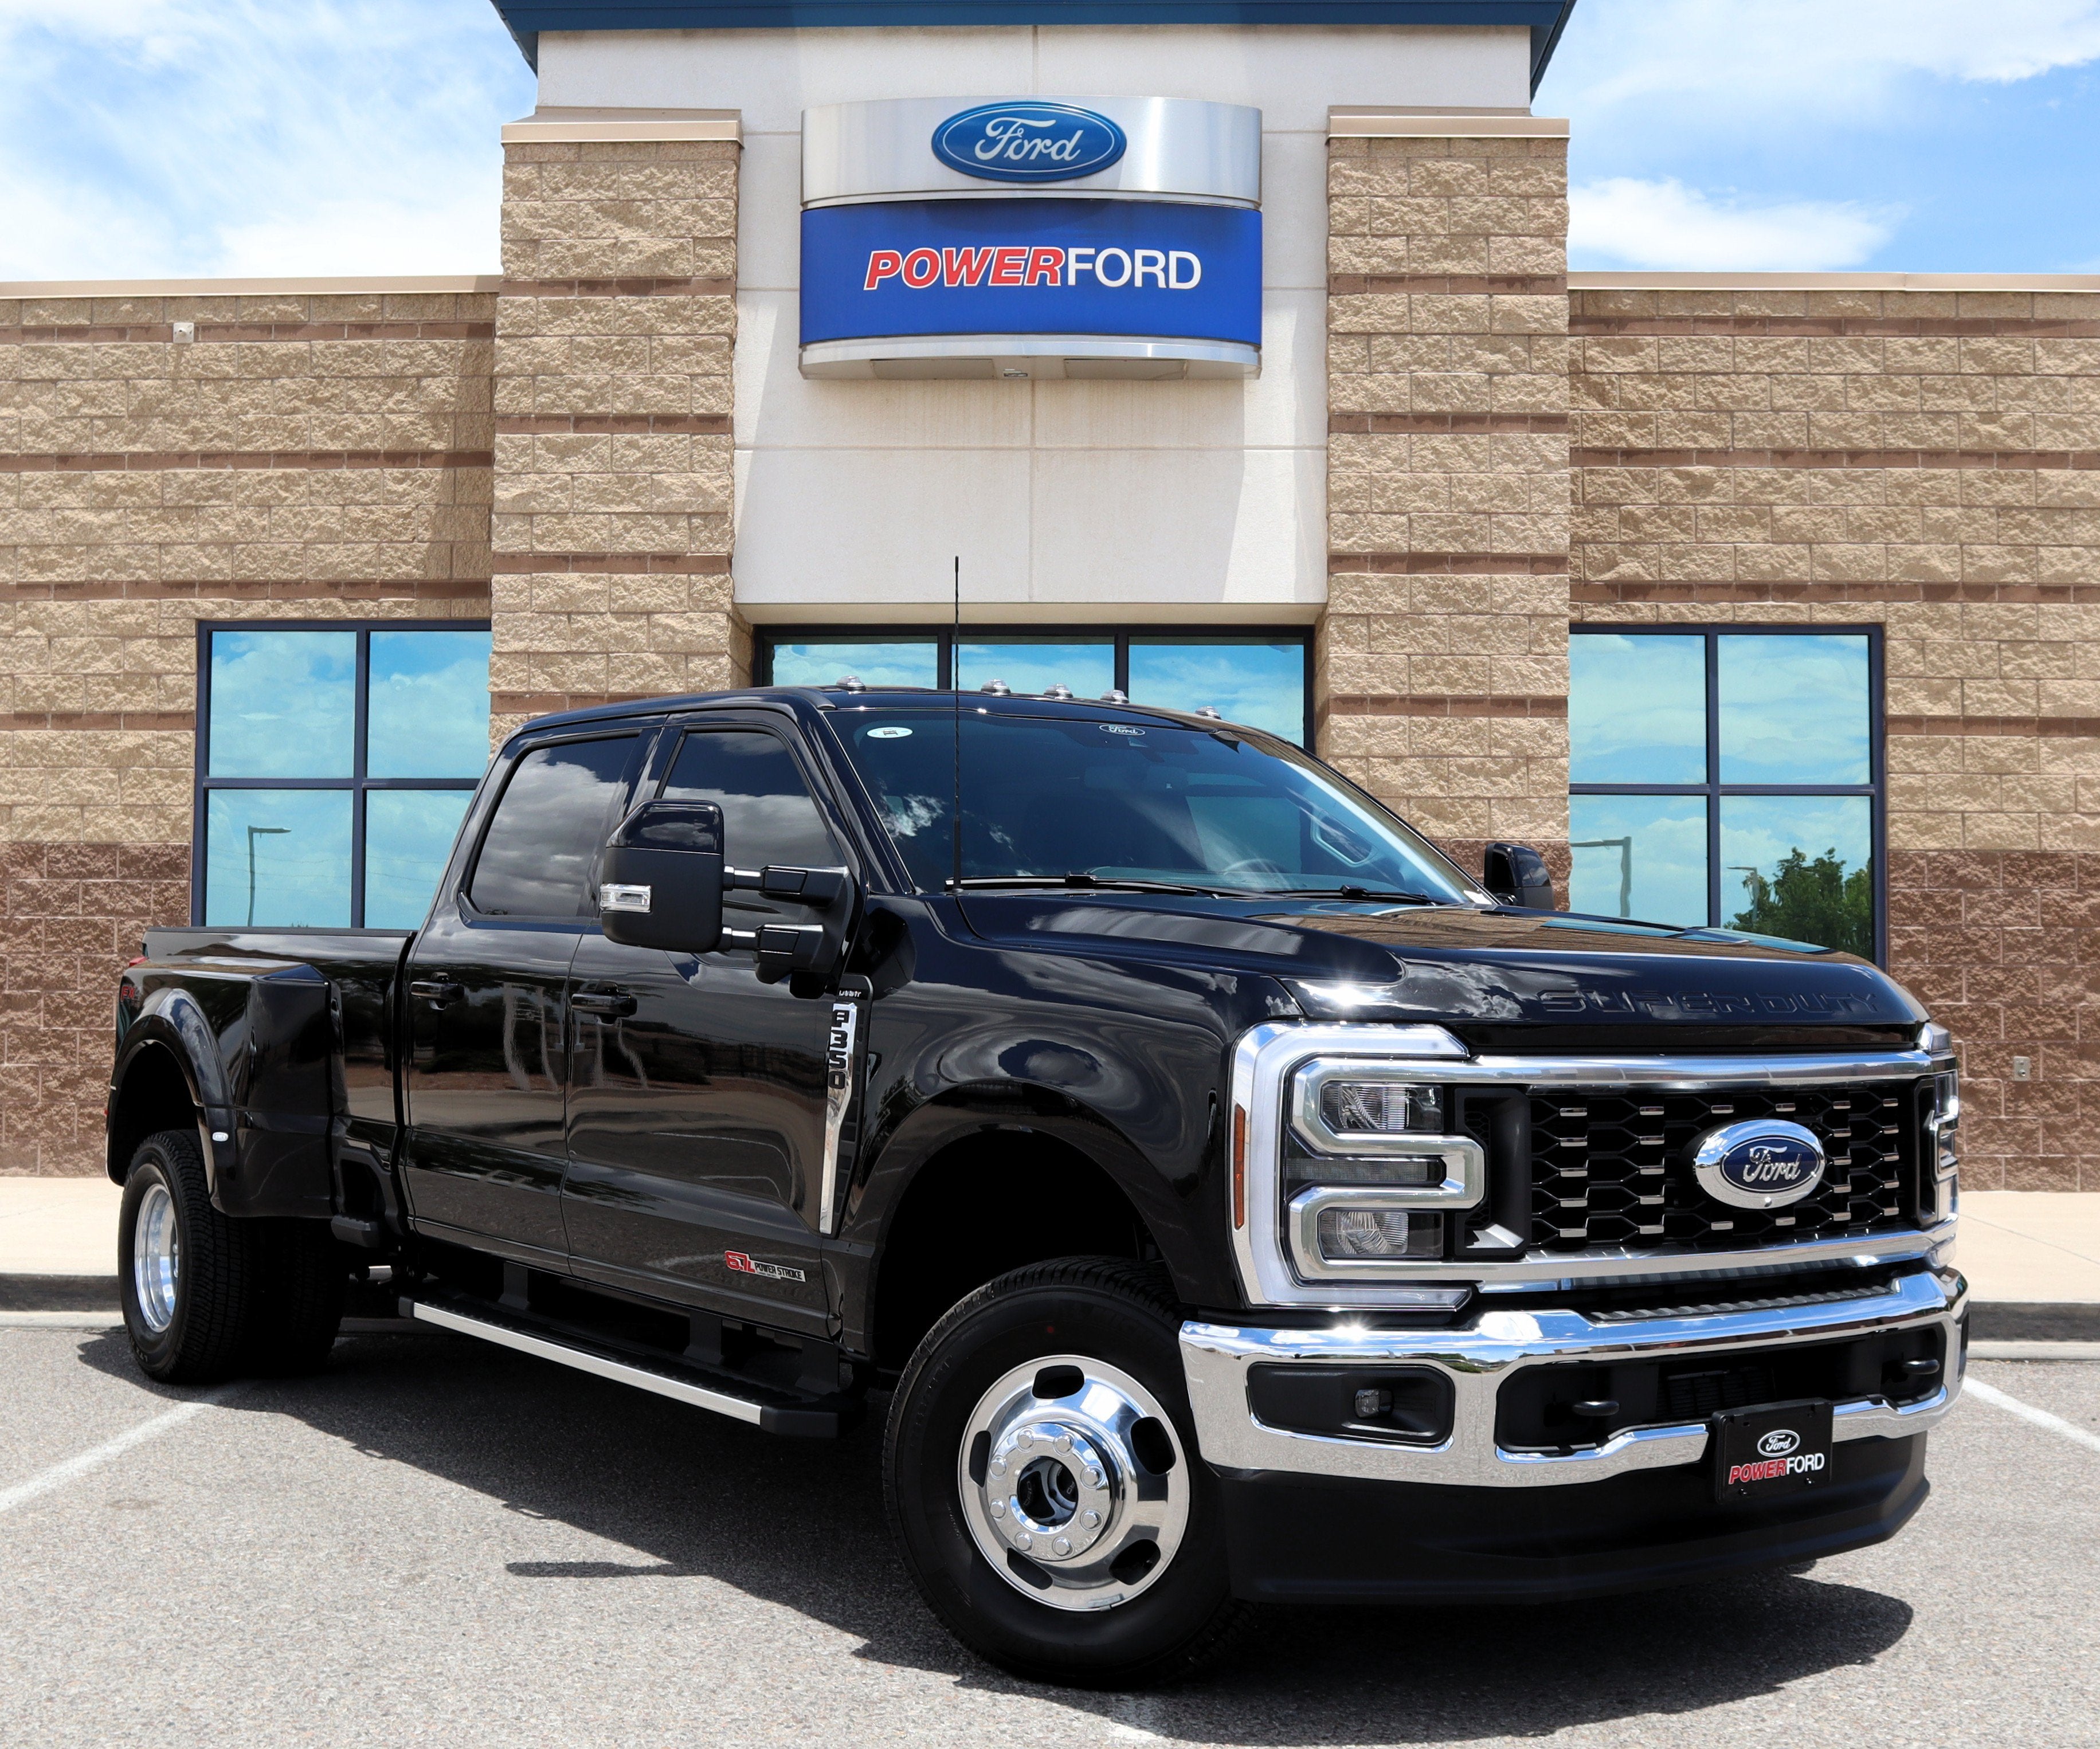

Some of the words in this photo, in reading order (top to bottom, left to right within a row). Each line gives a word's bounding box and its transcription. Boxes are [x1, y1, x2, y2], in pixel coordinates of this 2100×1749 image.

[974, 116, 1083, 162] Ford
[1108, 725, 1138, 734] Ford
[1537, 989, 1754, 1013] SUPER
[1756, 993, 1881, 1013] DUTY
[1743, 1145, 1803, 1183] Ford
[754, 1261, 777, 1275] POWER
[777, 1266, 803, 1280] STROKE
[1765, 1434, 1792, 1452] Ford
